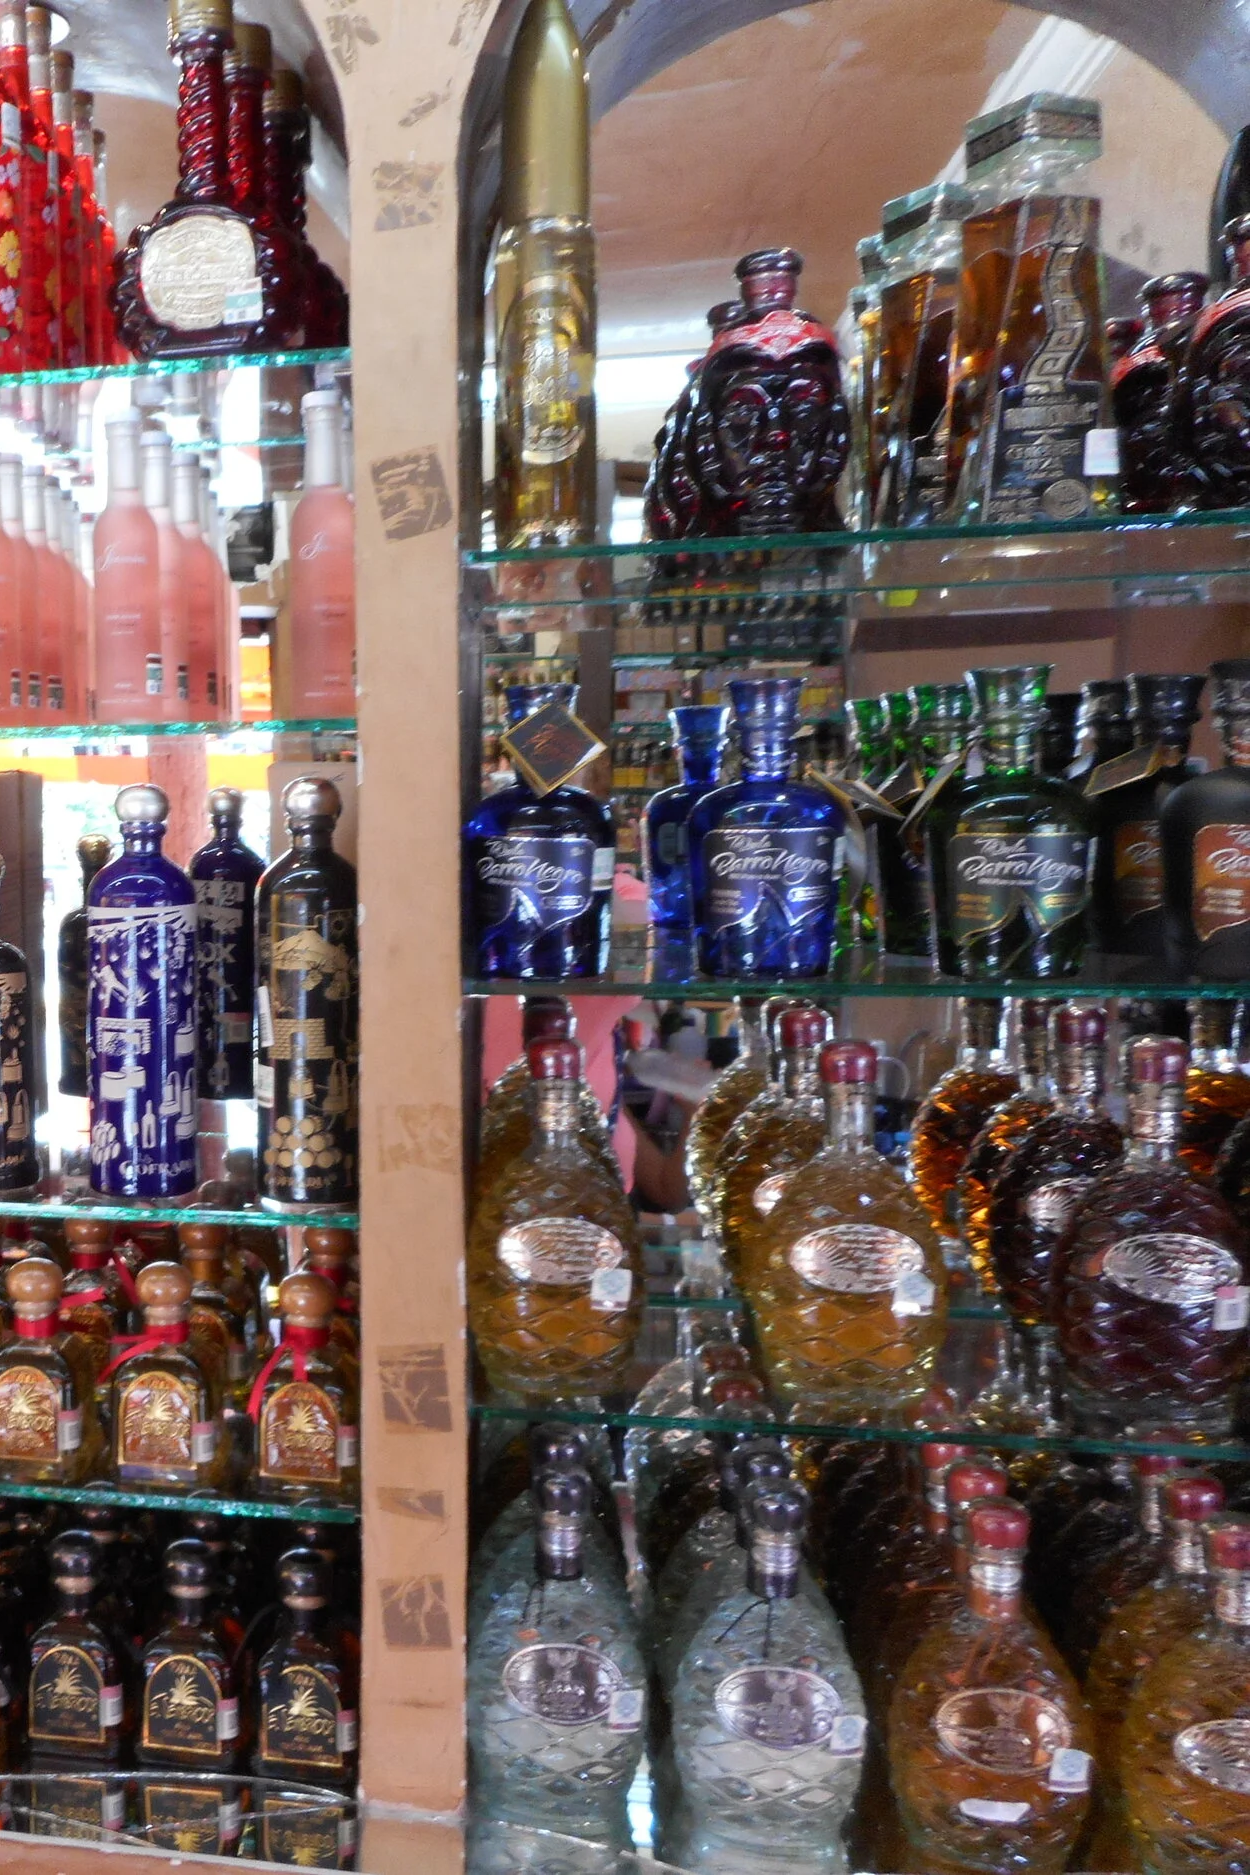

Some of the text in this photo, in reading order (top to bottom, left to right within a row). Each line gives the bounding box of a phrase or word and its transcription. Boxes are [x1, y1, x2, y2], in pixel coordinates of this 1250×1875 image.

[477, 856, 527, 880] Barro
[710, 848, 830, 886] Barro Negro
[957, 852, 1084, 892] Barro Negro
